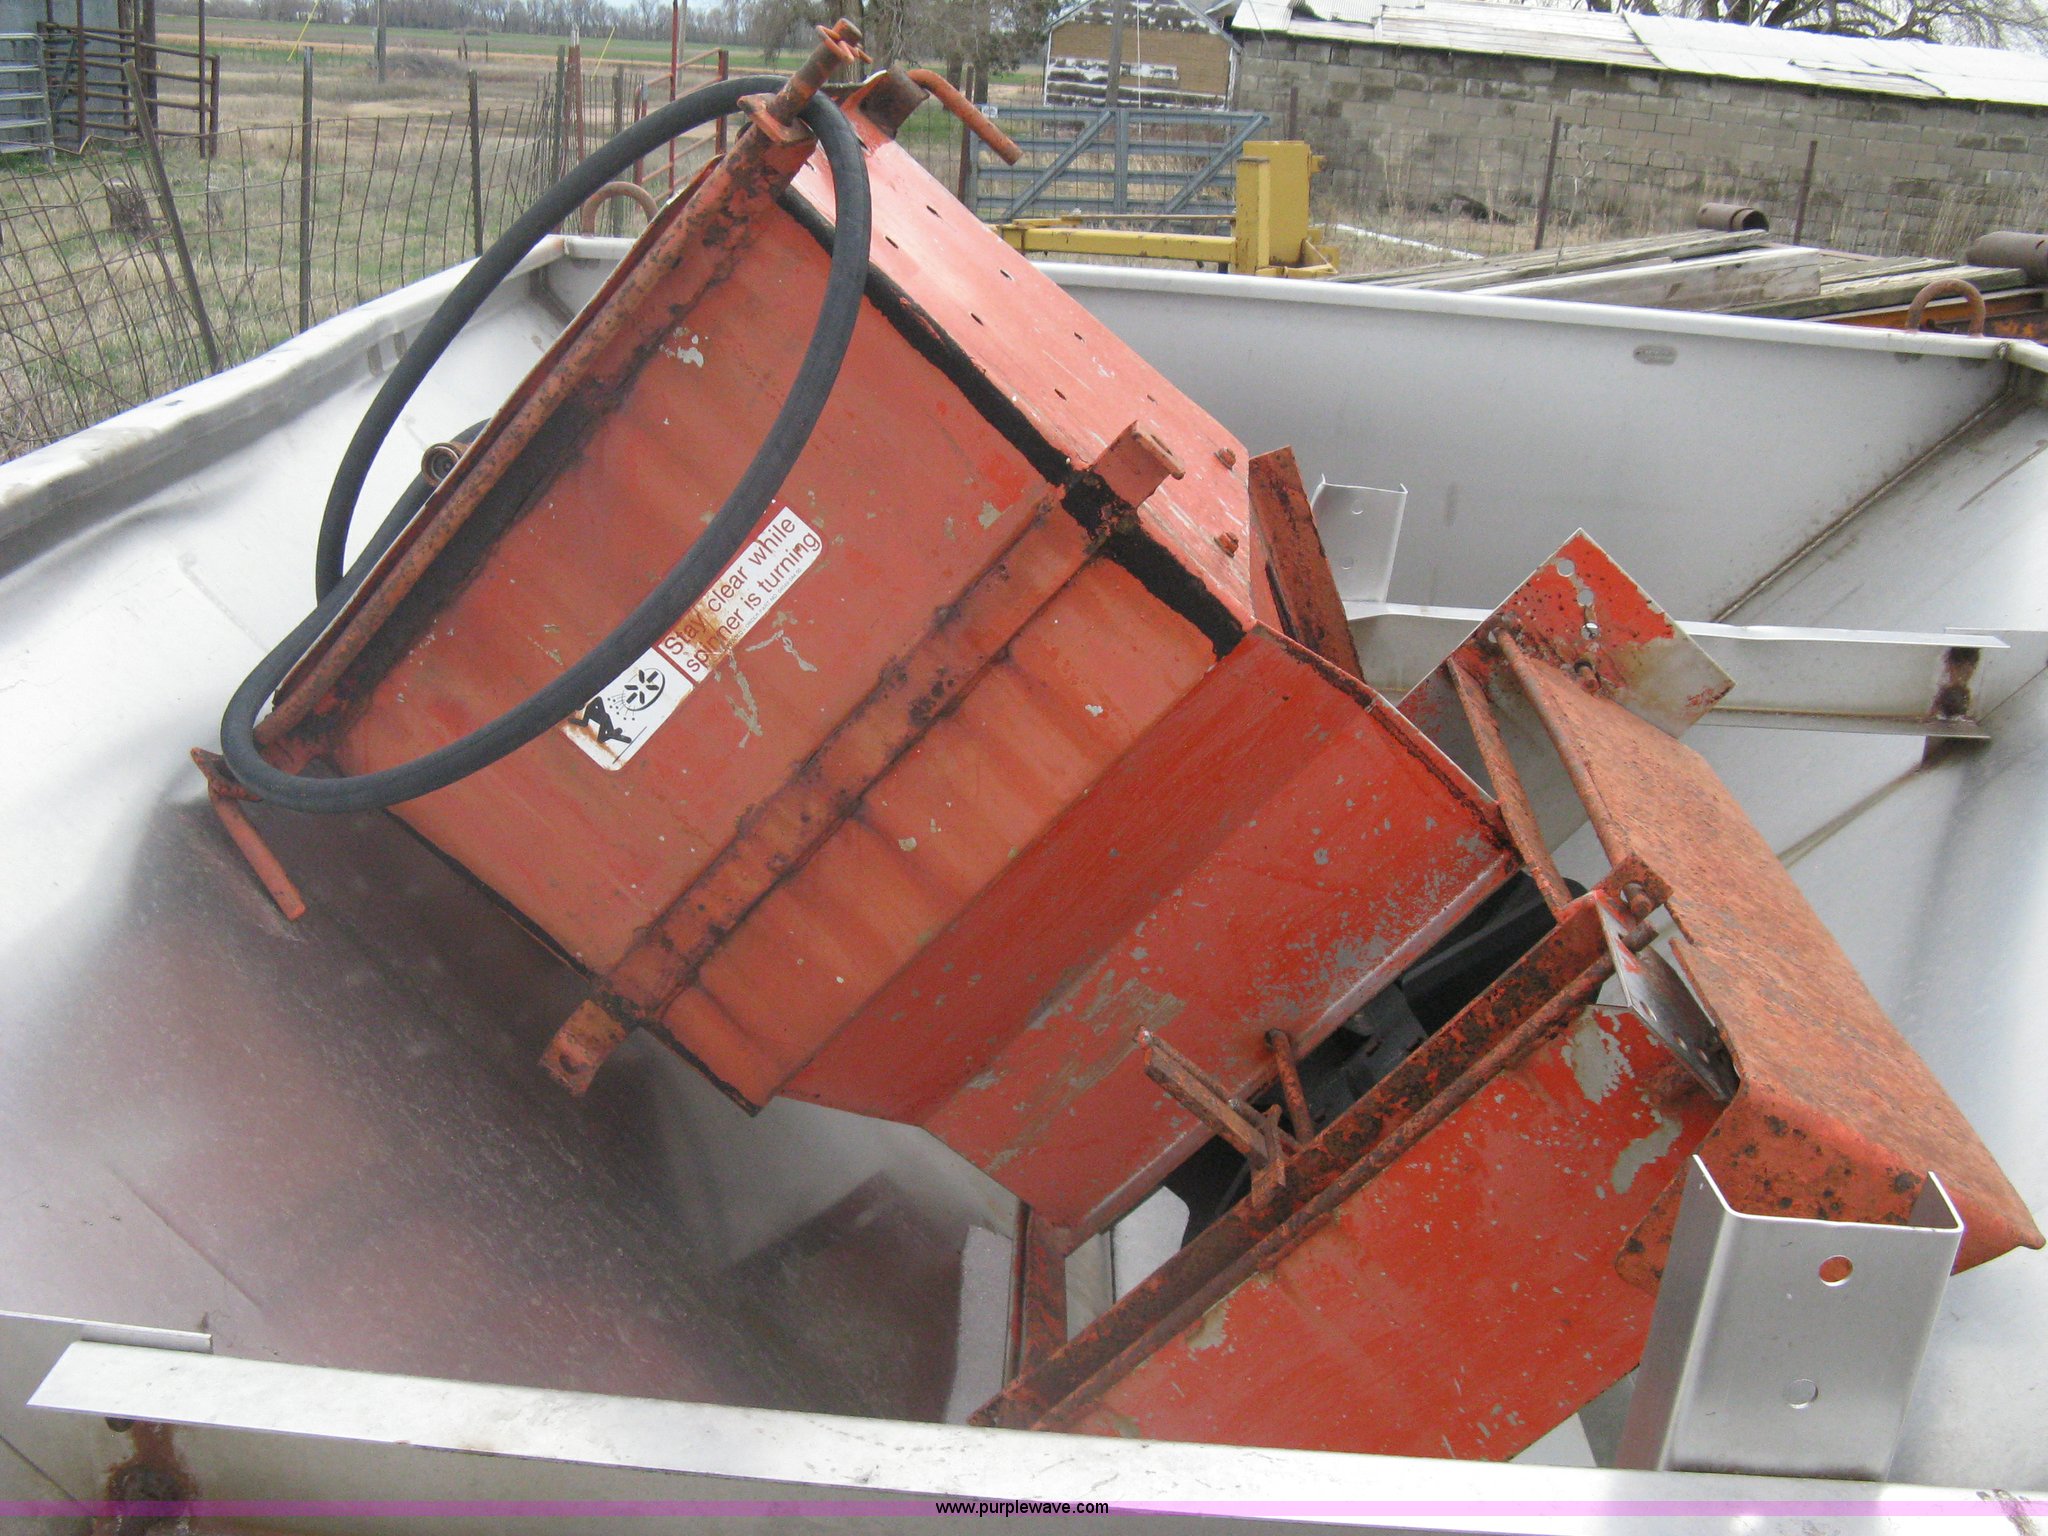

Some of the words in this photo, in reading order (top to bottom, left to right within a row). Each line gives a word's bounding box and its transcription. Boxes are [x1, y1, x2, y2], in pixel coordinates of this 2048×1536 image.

[665, 607, 708, 655] Stay
[708, 566, 748, 613] clear
[748, 518, 795, 566] while
[686, 608, 744, 672] spinner
[740, 595, 762, 611] is
[759, 531, 820, 594] turning
